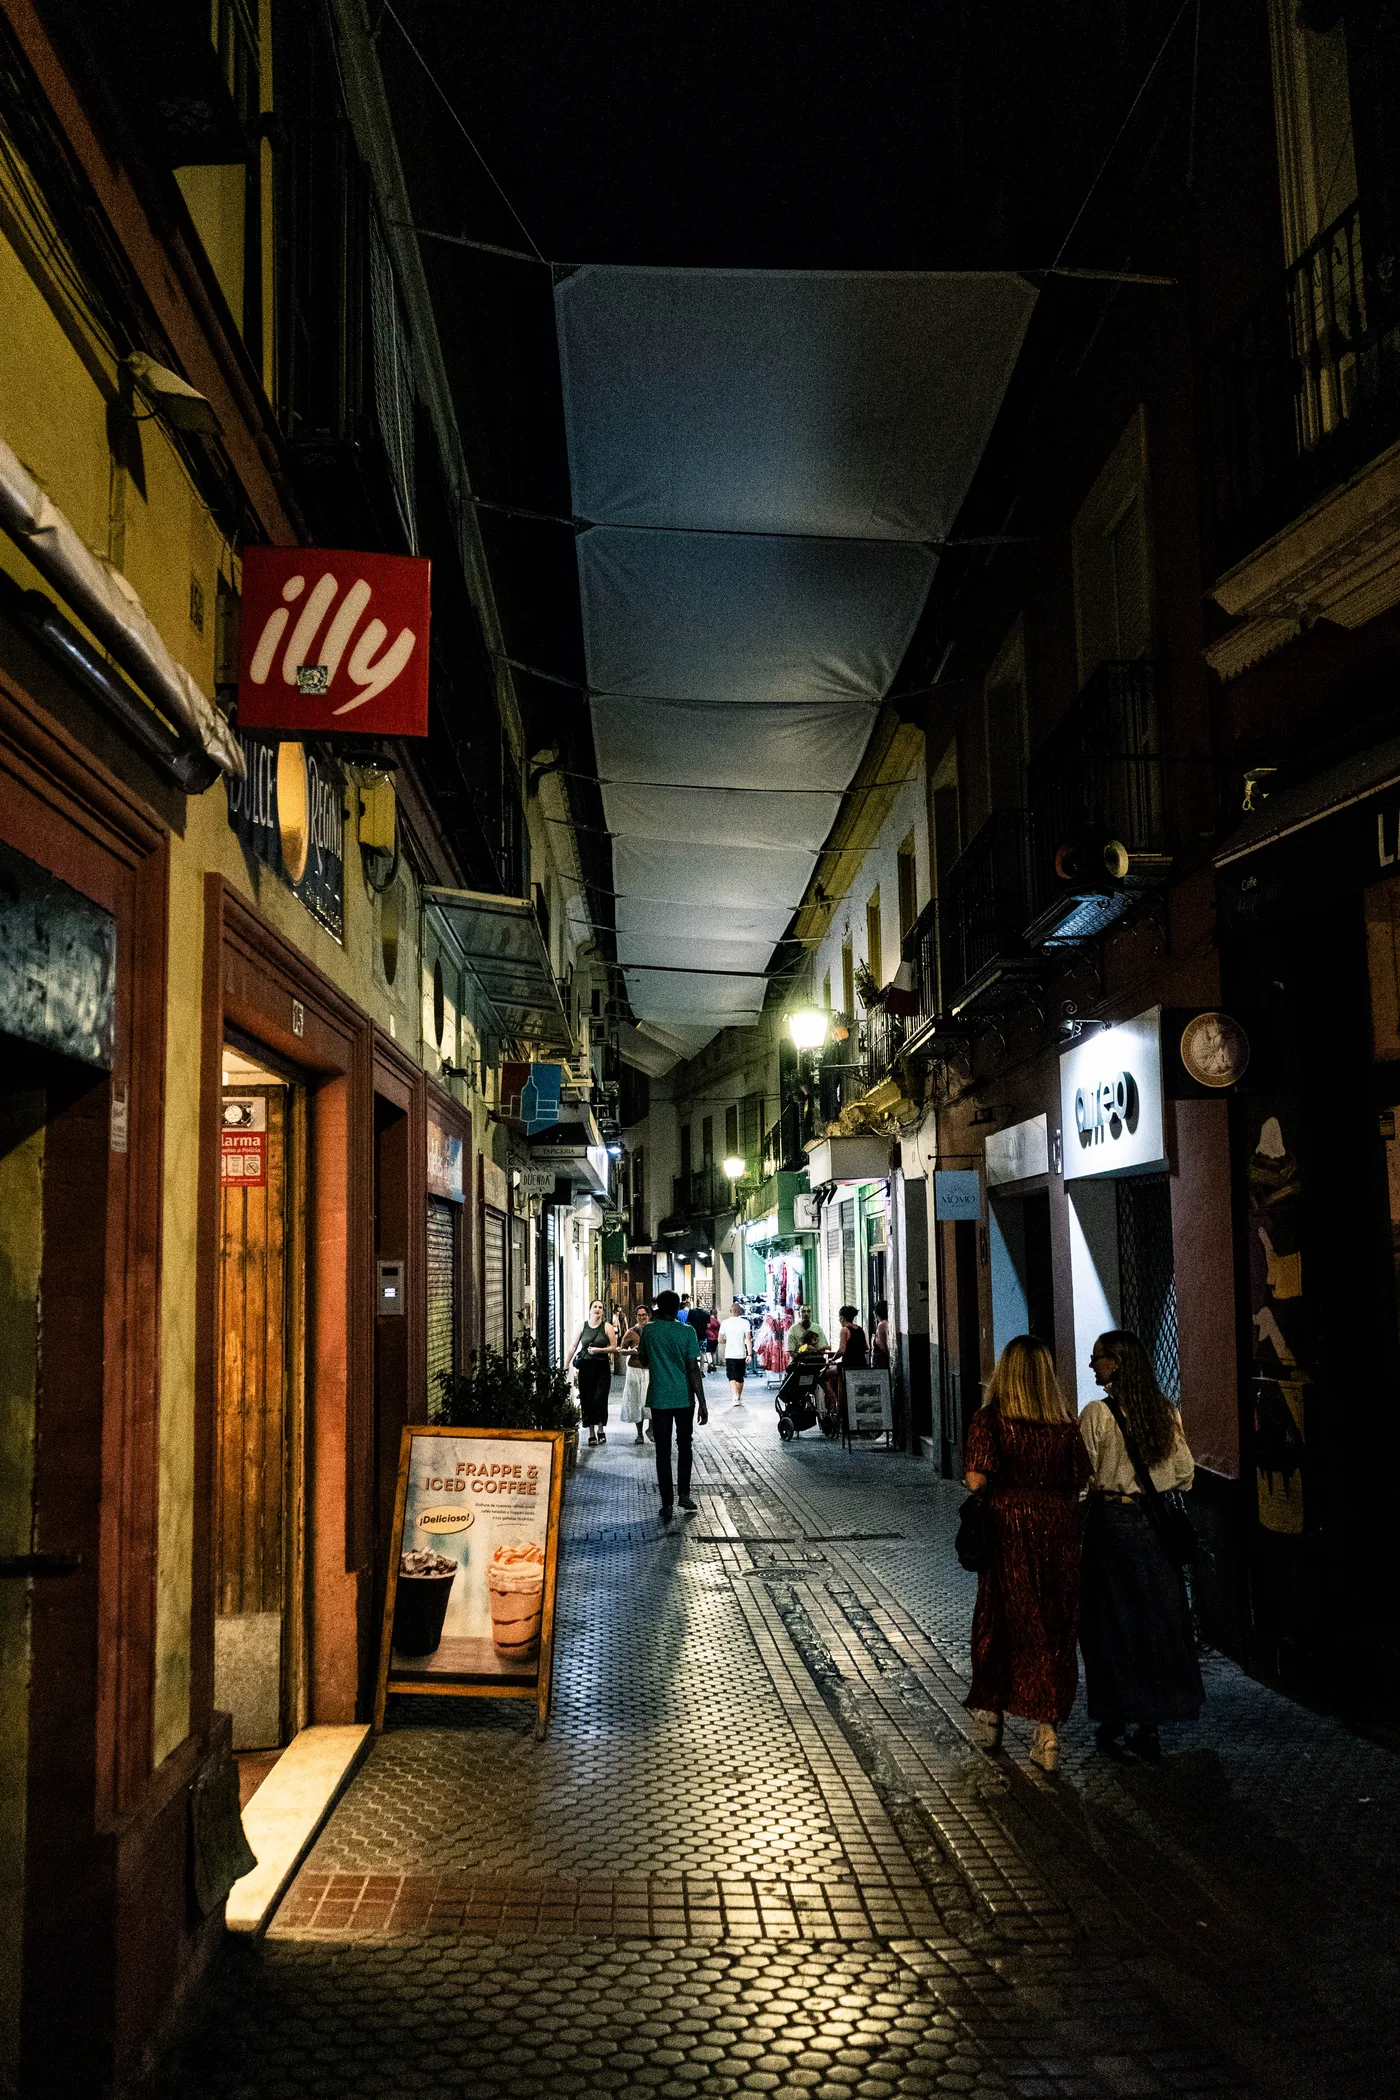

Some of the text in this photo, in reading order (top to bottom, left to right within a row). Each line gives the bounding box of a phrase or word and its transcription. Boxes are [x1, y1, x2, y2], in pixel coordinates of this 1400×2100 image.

[250, 572, 416, 715] illy
[1377, 805, 1400, 868] L
[221, 1134, 261, 1147] larma
[456, 1462, 539, 1480] FRAPPE &
[425, 1477, 537, 1496] ICED COFFEE
[419, 1513, 470, 1526] ¡Delicioso!
